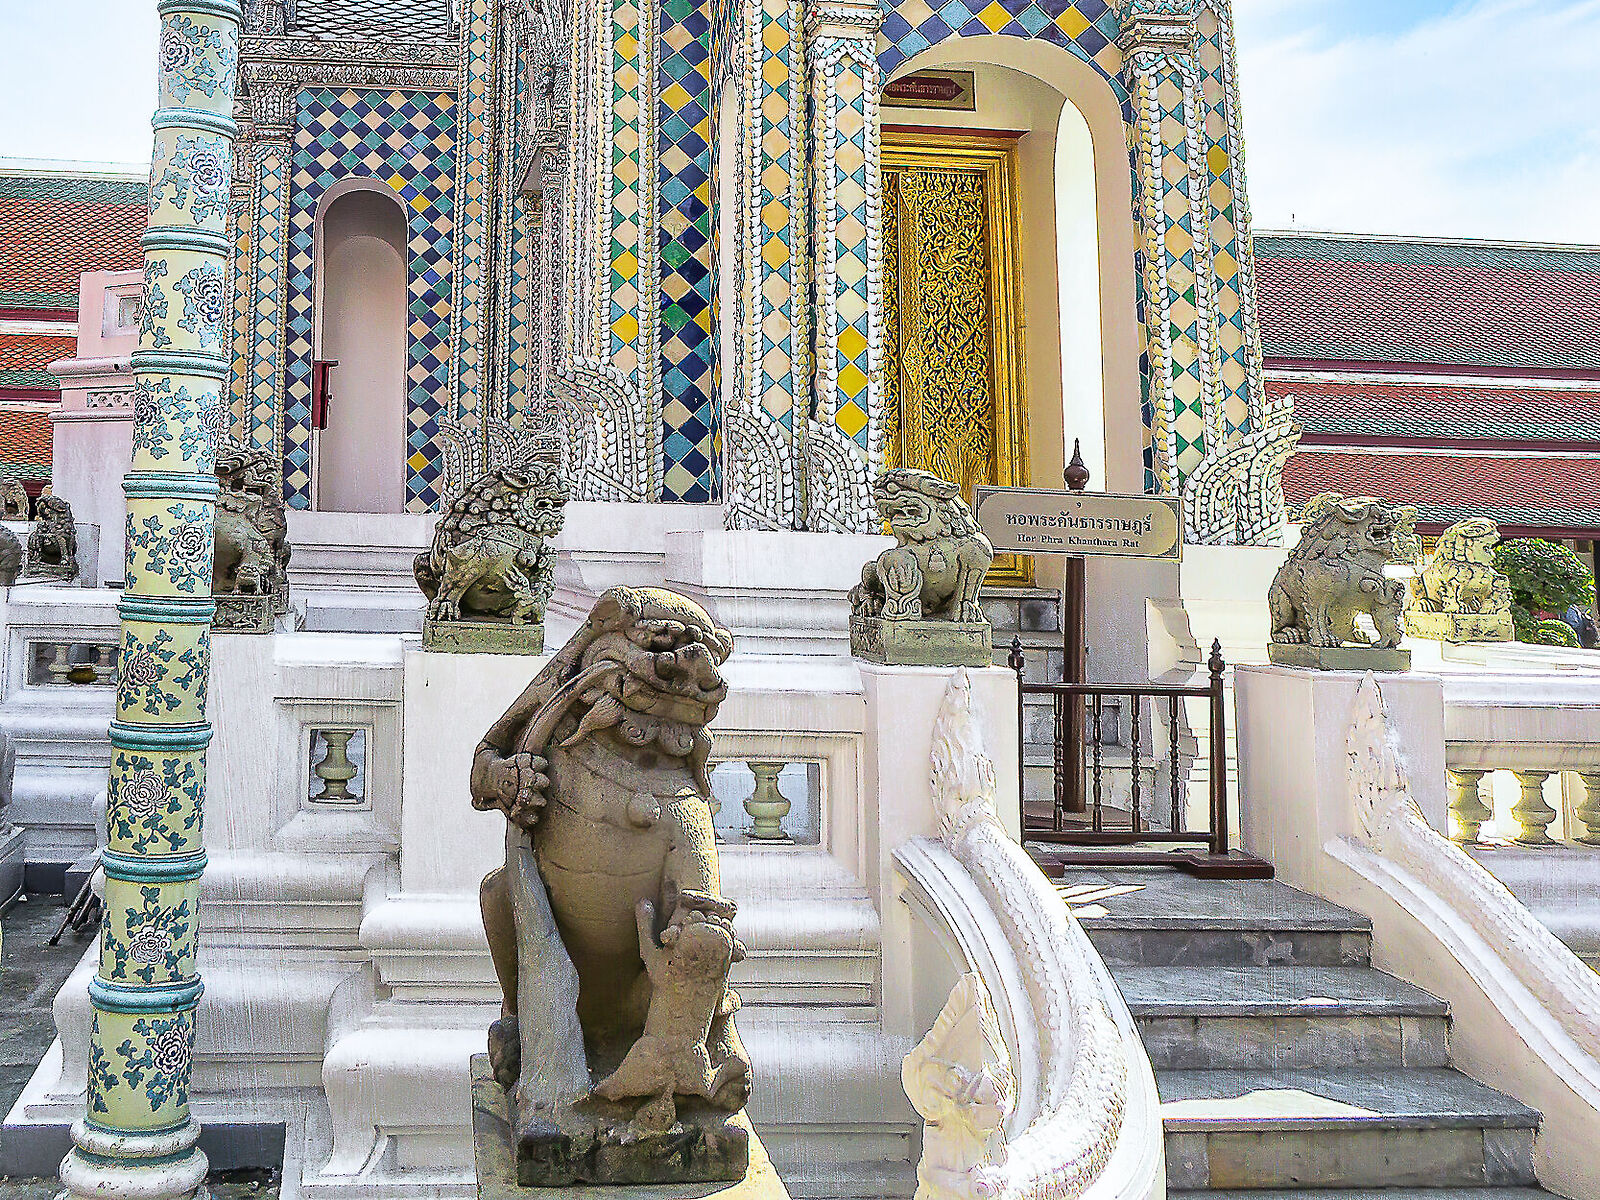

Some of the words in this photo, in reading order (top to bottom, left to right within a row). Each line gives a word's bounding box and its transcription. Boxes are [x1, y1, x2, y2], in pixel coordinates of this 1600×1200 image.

[1005, 510, 1153, 536] หอพระคันธารราษฎร์
[1017, 533, 1037, 543] Hor
[1040, 535, 1063, 544] Phra
[1068, 536, 1118, 547] Khanthara
[1121, 538, 1140, 548] Rat
